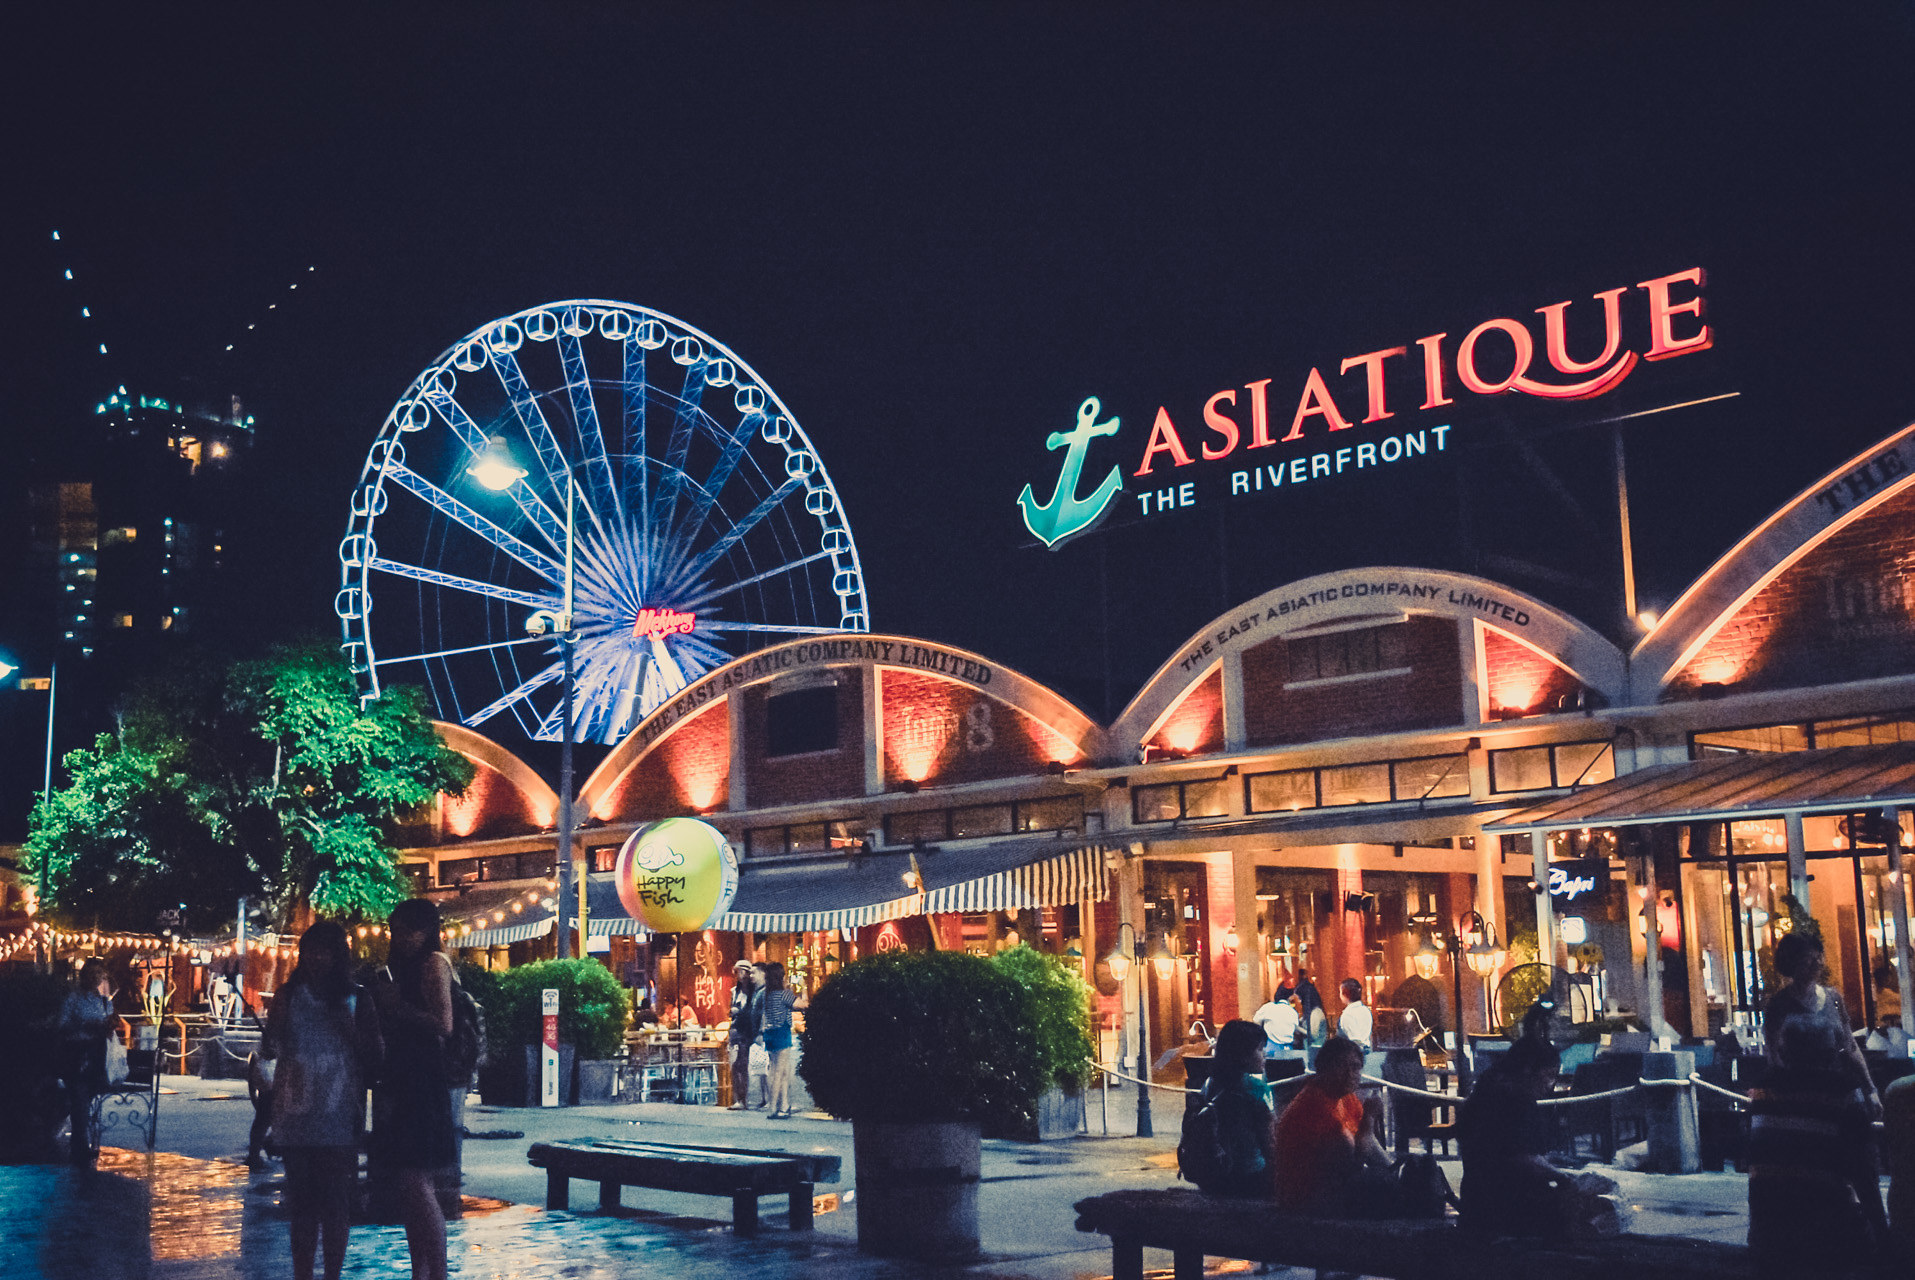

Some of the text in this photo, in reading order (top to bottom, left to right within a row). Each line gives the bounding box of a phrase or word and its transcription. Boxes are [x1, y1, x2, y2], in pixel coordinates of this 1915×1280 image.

[1133, 266, 1712, 477] ASIATIQUE
[1138, 425, 1451, 516] THE RIVERFRONT
[1815, 448, 1908, 515] THE
[1180, 583, 1530, 671] THE EAST ASIATIC COMPANY LIMITED
[640, 640, 992, 744] THE EAST ASIATIC COMPANY LIMITED
[637, 875, 685, 889] Happy
[638, 889, 684, 908] Fish
